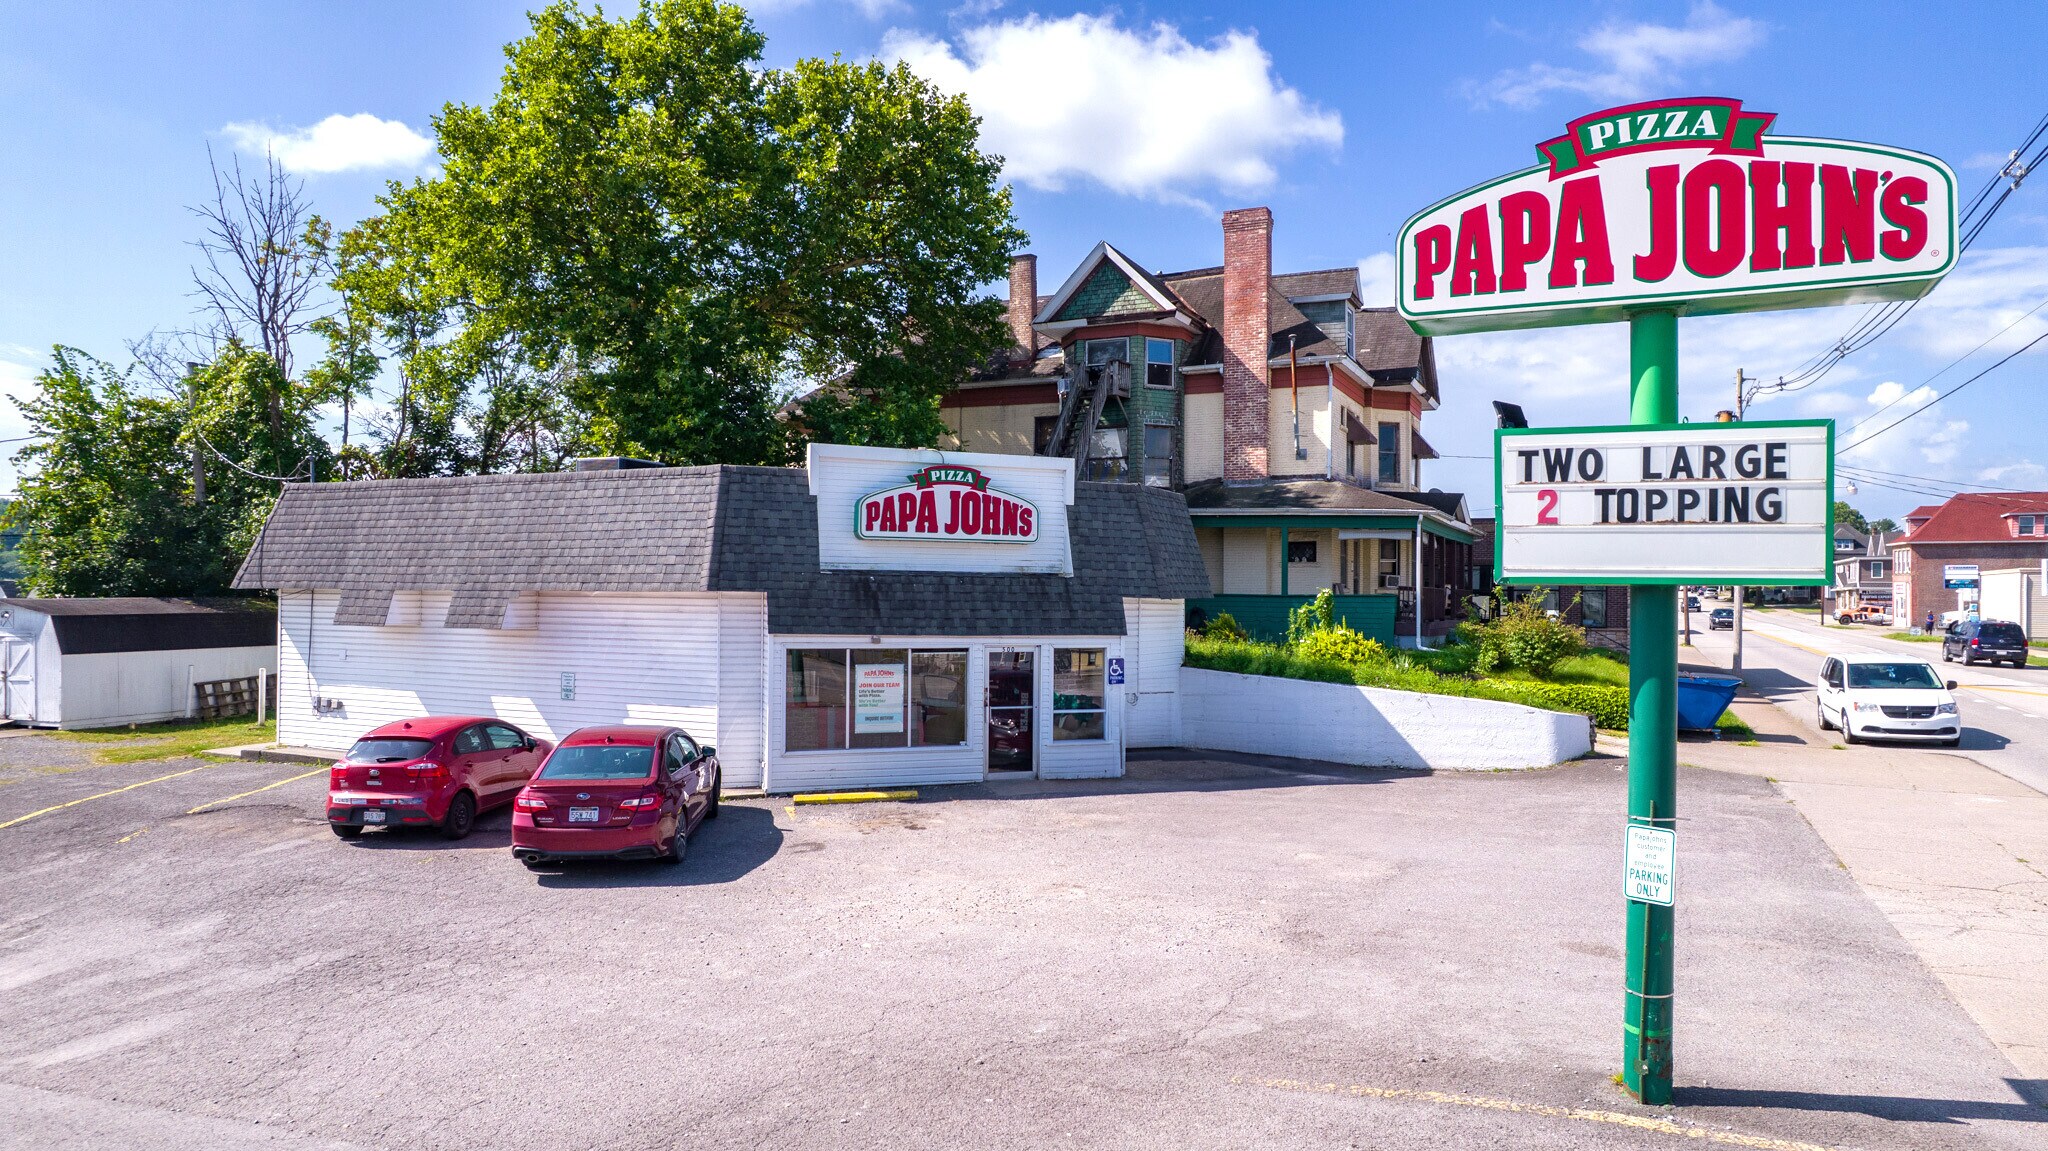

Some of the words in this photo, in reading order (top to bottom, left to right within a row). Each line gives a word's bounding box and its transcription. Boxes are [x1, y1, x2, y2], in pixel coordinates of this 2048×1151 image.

[1587, 108, 1720, 151] PIZZA
[1413, 174, 1615, 301] PAPA
[1632, 158, 1928, 284] JOHN'S
[930, 469, 974, 484] PIZZA
[1517, 447, 1604, 483] TWO
[1641, 442, 1788, 480] LARGE
[865, 490, 939, 534] PAPA
[944, 490, 1033, 537] JOHN'S
[1536, 489, 1559, 525] 2
[1594, 486, 1783, 524] TOPPING
[1637, 844, 1665, 852] customer
[1629, 868, 1668, 885] PARKING
[1636, 882, 1660, 898] ONLY
